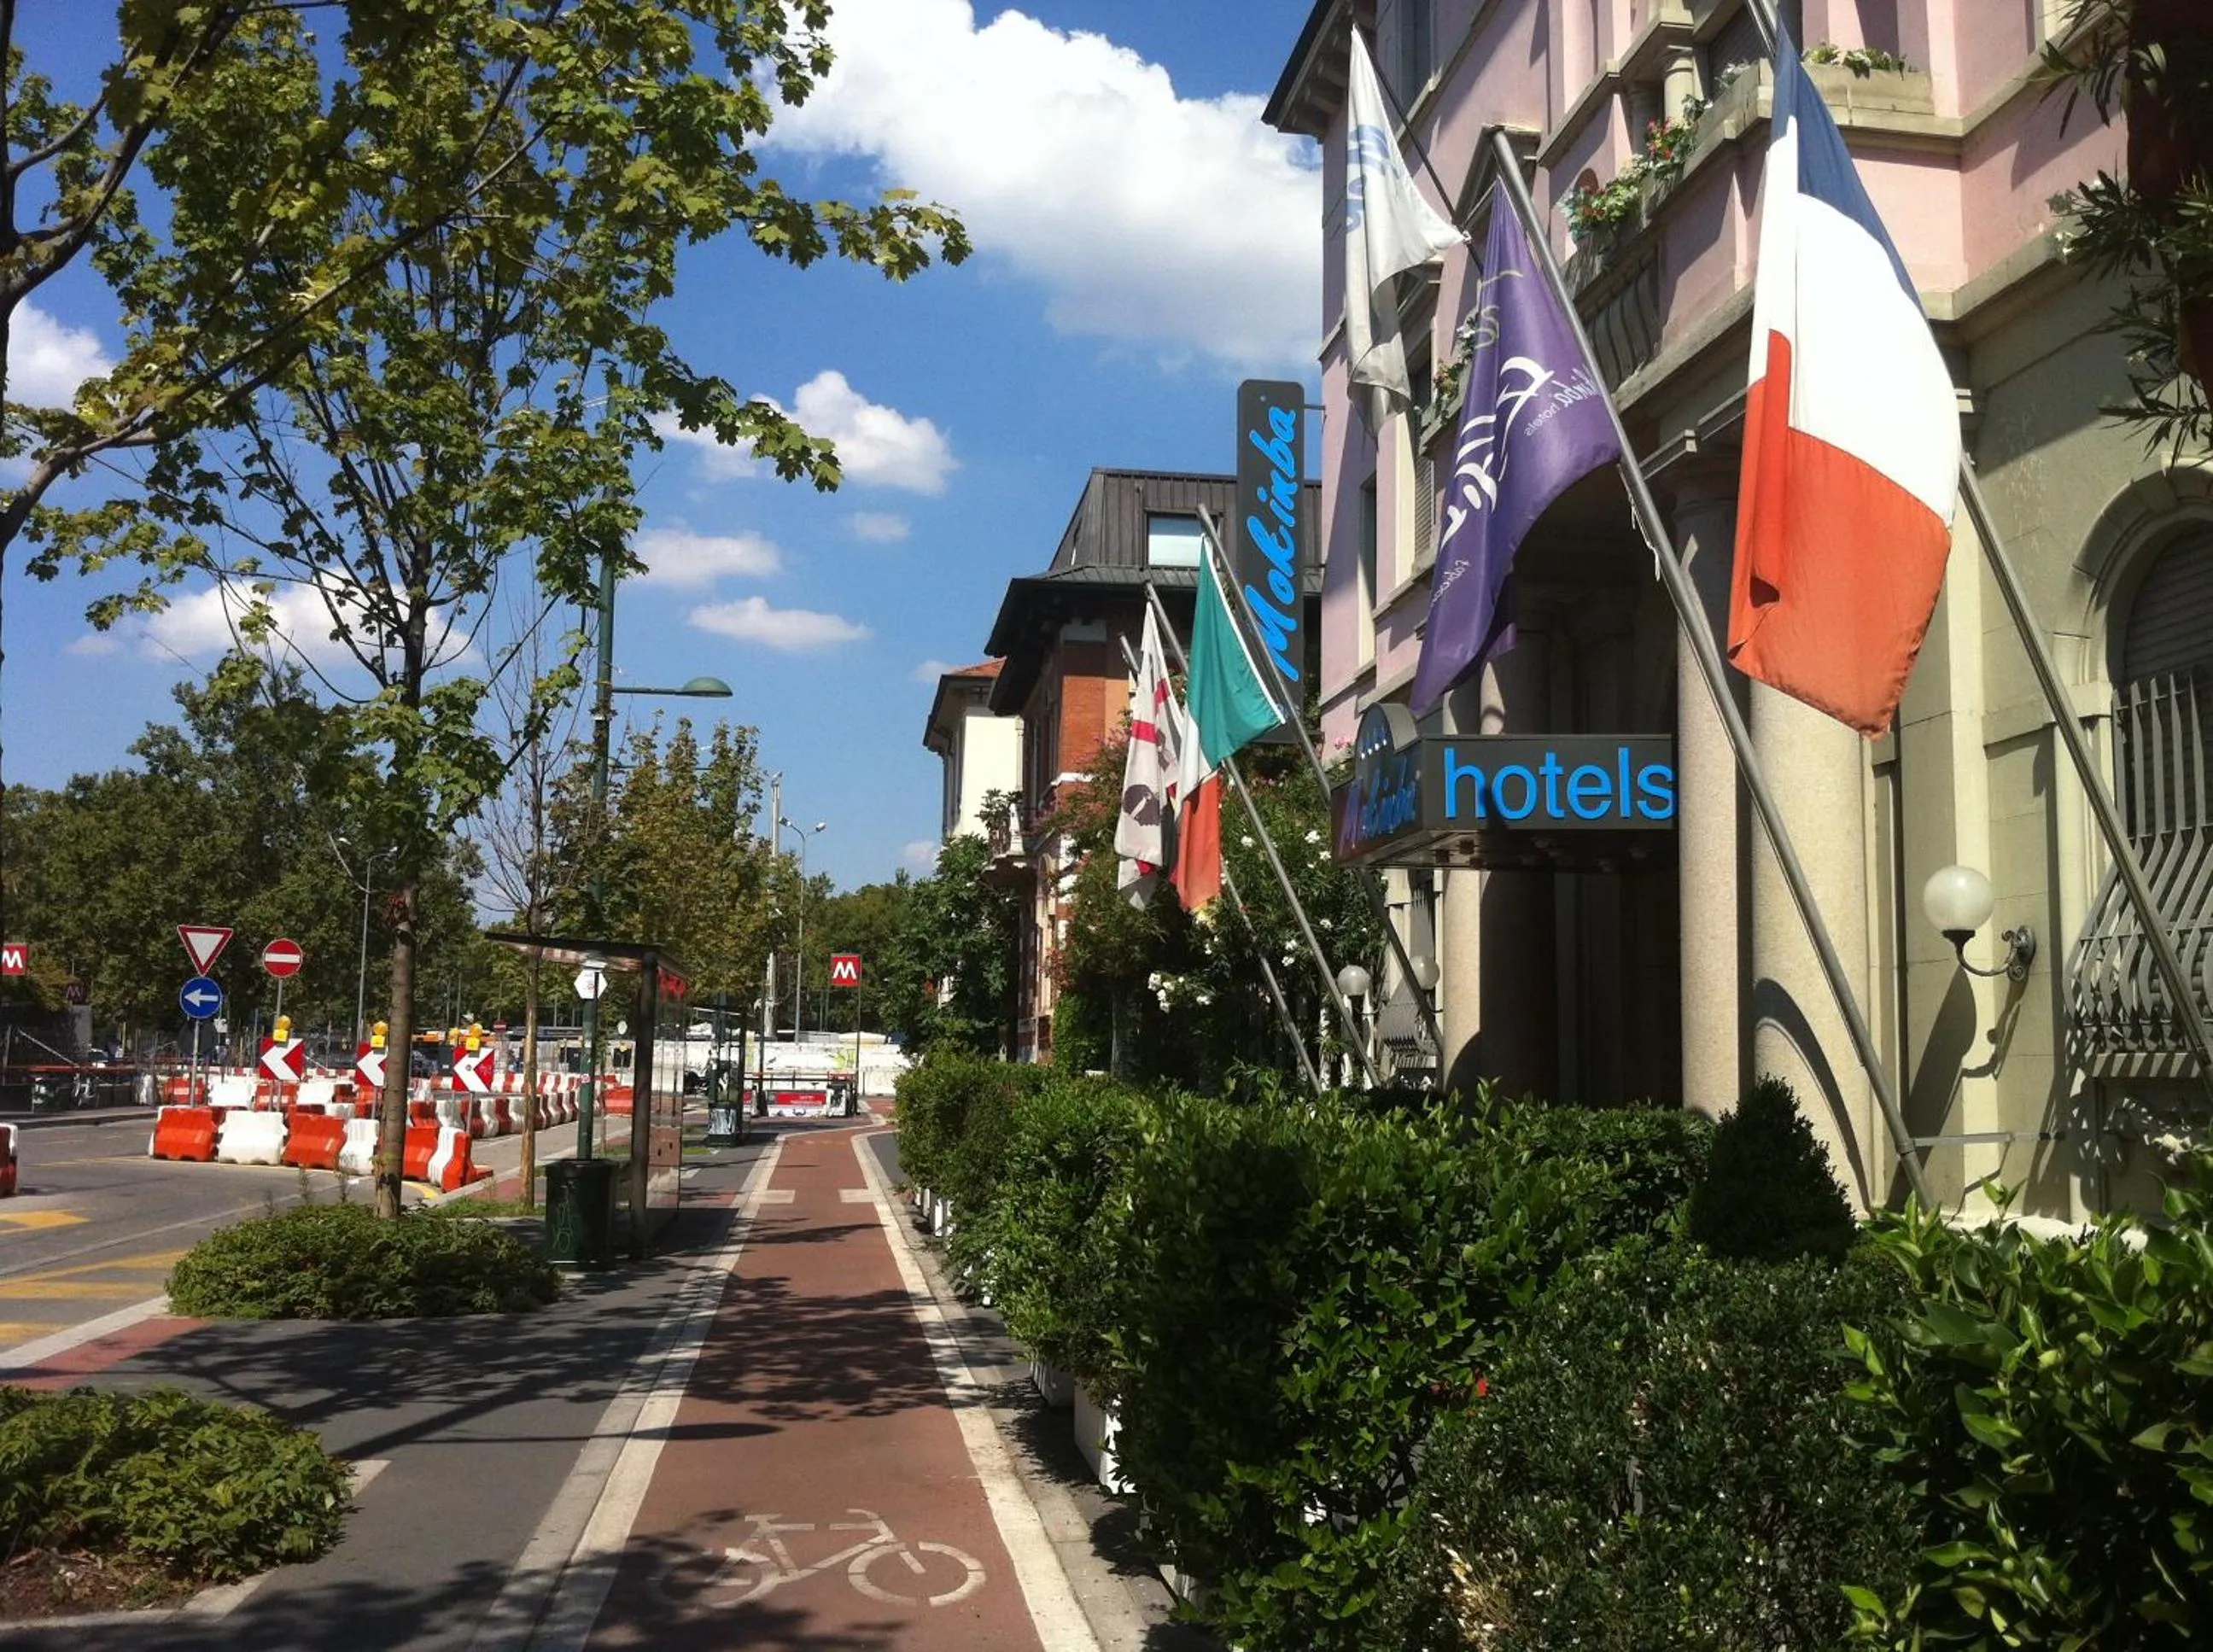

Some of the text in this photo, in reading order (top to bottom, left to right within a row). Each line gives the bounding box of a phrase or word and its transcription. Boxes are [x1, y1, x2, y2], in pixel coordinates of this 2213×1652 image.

[1245, 405, 1299, 682] Mokinba
[1444, 747, 1675, 820] hotels
[2, 950, 23, 968] M
[832, 960, 857, 980] M
